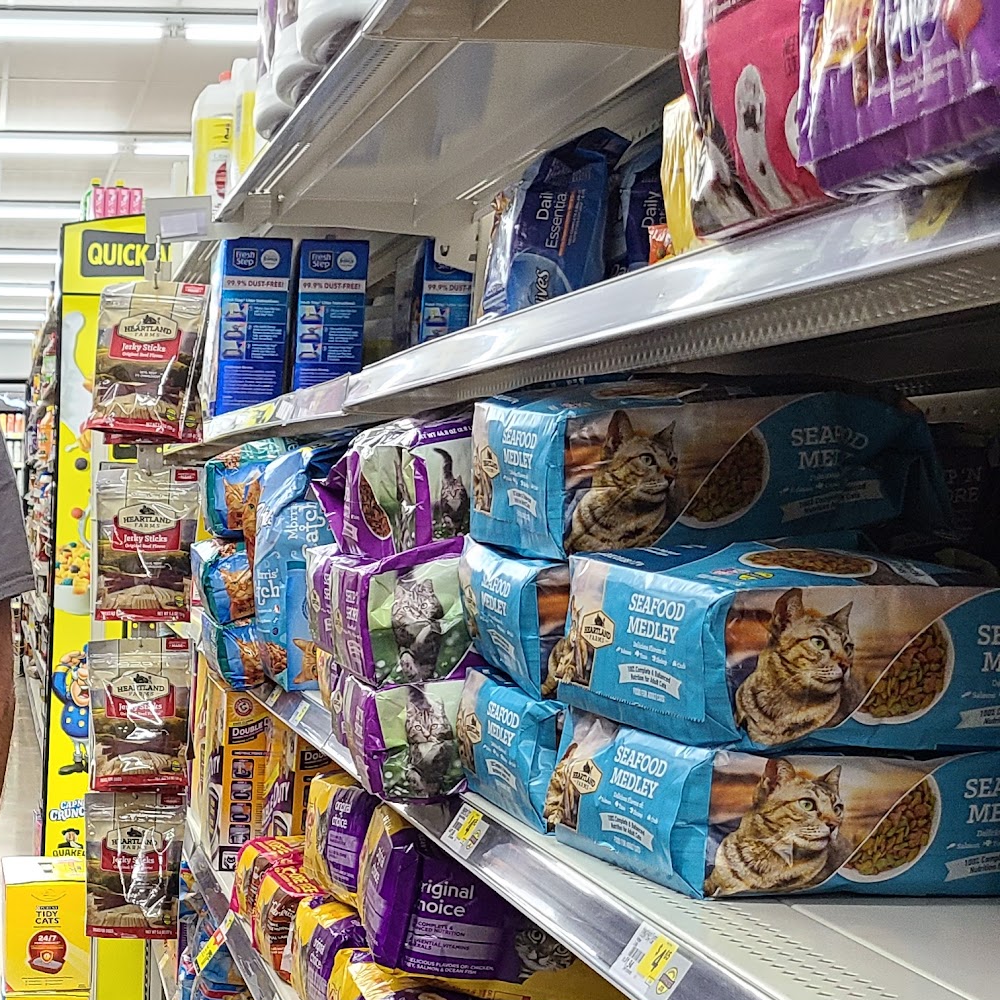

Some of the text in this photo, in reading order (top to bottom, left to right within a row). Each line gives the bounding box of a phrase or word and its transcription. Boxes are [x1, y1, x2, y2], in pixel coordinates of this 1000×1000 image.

[536, 192, 554, 221] Dail
[641, 190, 661, 228] Daily
[545, 193, 568, 249] Essentia
[87, 242, 150, 267] QUICK
[235, 250, 256, 259] Fresh
[235, 257, 254, 267] Step
[311, 252, 332, 261] Fresh
[312, 260, 331, 269] Step
[226, 279, 247, 287] 99.9%
[324, 282, 361, 290] DUST-FREE!
[427, 283, 448, 292] 99.9%
[124, 325, 172, 335] HEARTLAND
[121, 342, 166, 353] Jerky Sticks
[501, 427, 538, 449] SEAFOOD
[503, 447, 534, 470] MEDLEY
[123, 515, 171, 524] HEARTLAND
[123, 534, 168, 544] Jerky Sticks
[481, 575, 511, 598] SEAFOOD
[480, 592, 508, 617] MEDLEY
[628, 592, 685, 623] SEAFOOD
[583, 625, 612, 640] HEARTLAND
[627, 615, 679, 645] MEDLEY
[117, 685, 165, 693] HEARTLAND
[486, 700, 520, 729] SEAFOOD
[487, 718, 516, 747] MEDLEY
[614, 745, 668, 778] SEAFOOD
[572, 771, 597, 788] HEARTLAND
[610, 766, 660, 799] MEDLEY
[49, 806, 85, 821] CRUNC
[420, 879, 475, 901] riginal
[35, 910, 58, 918] TIDY
[37, 934, 57, 942] 24/7
